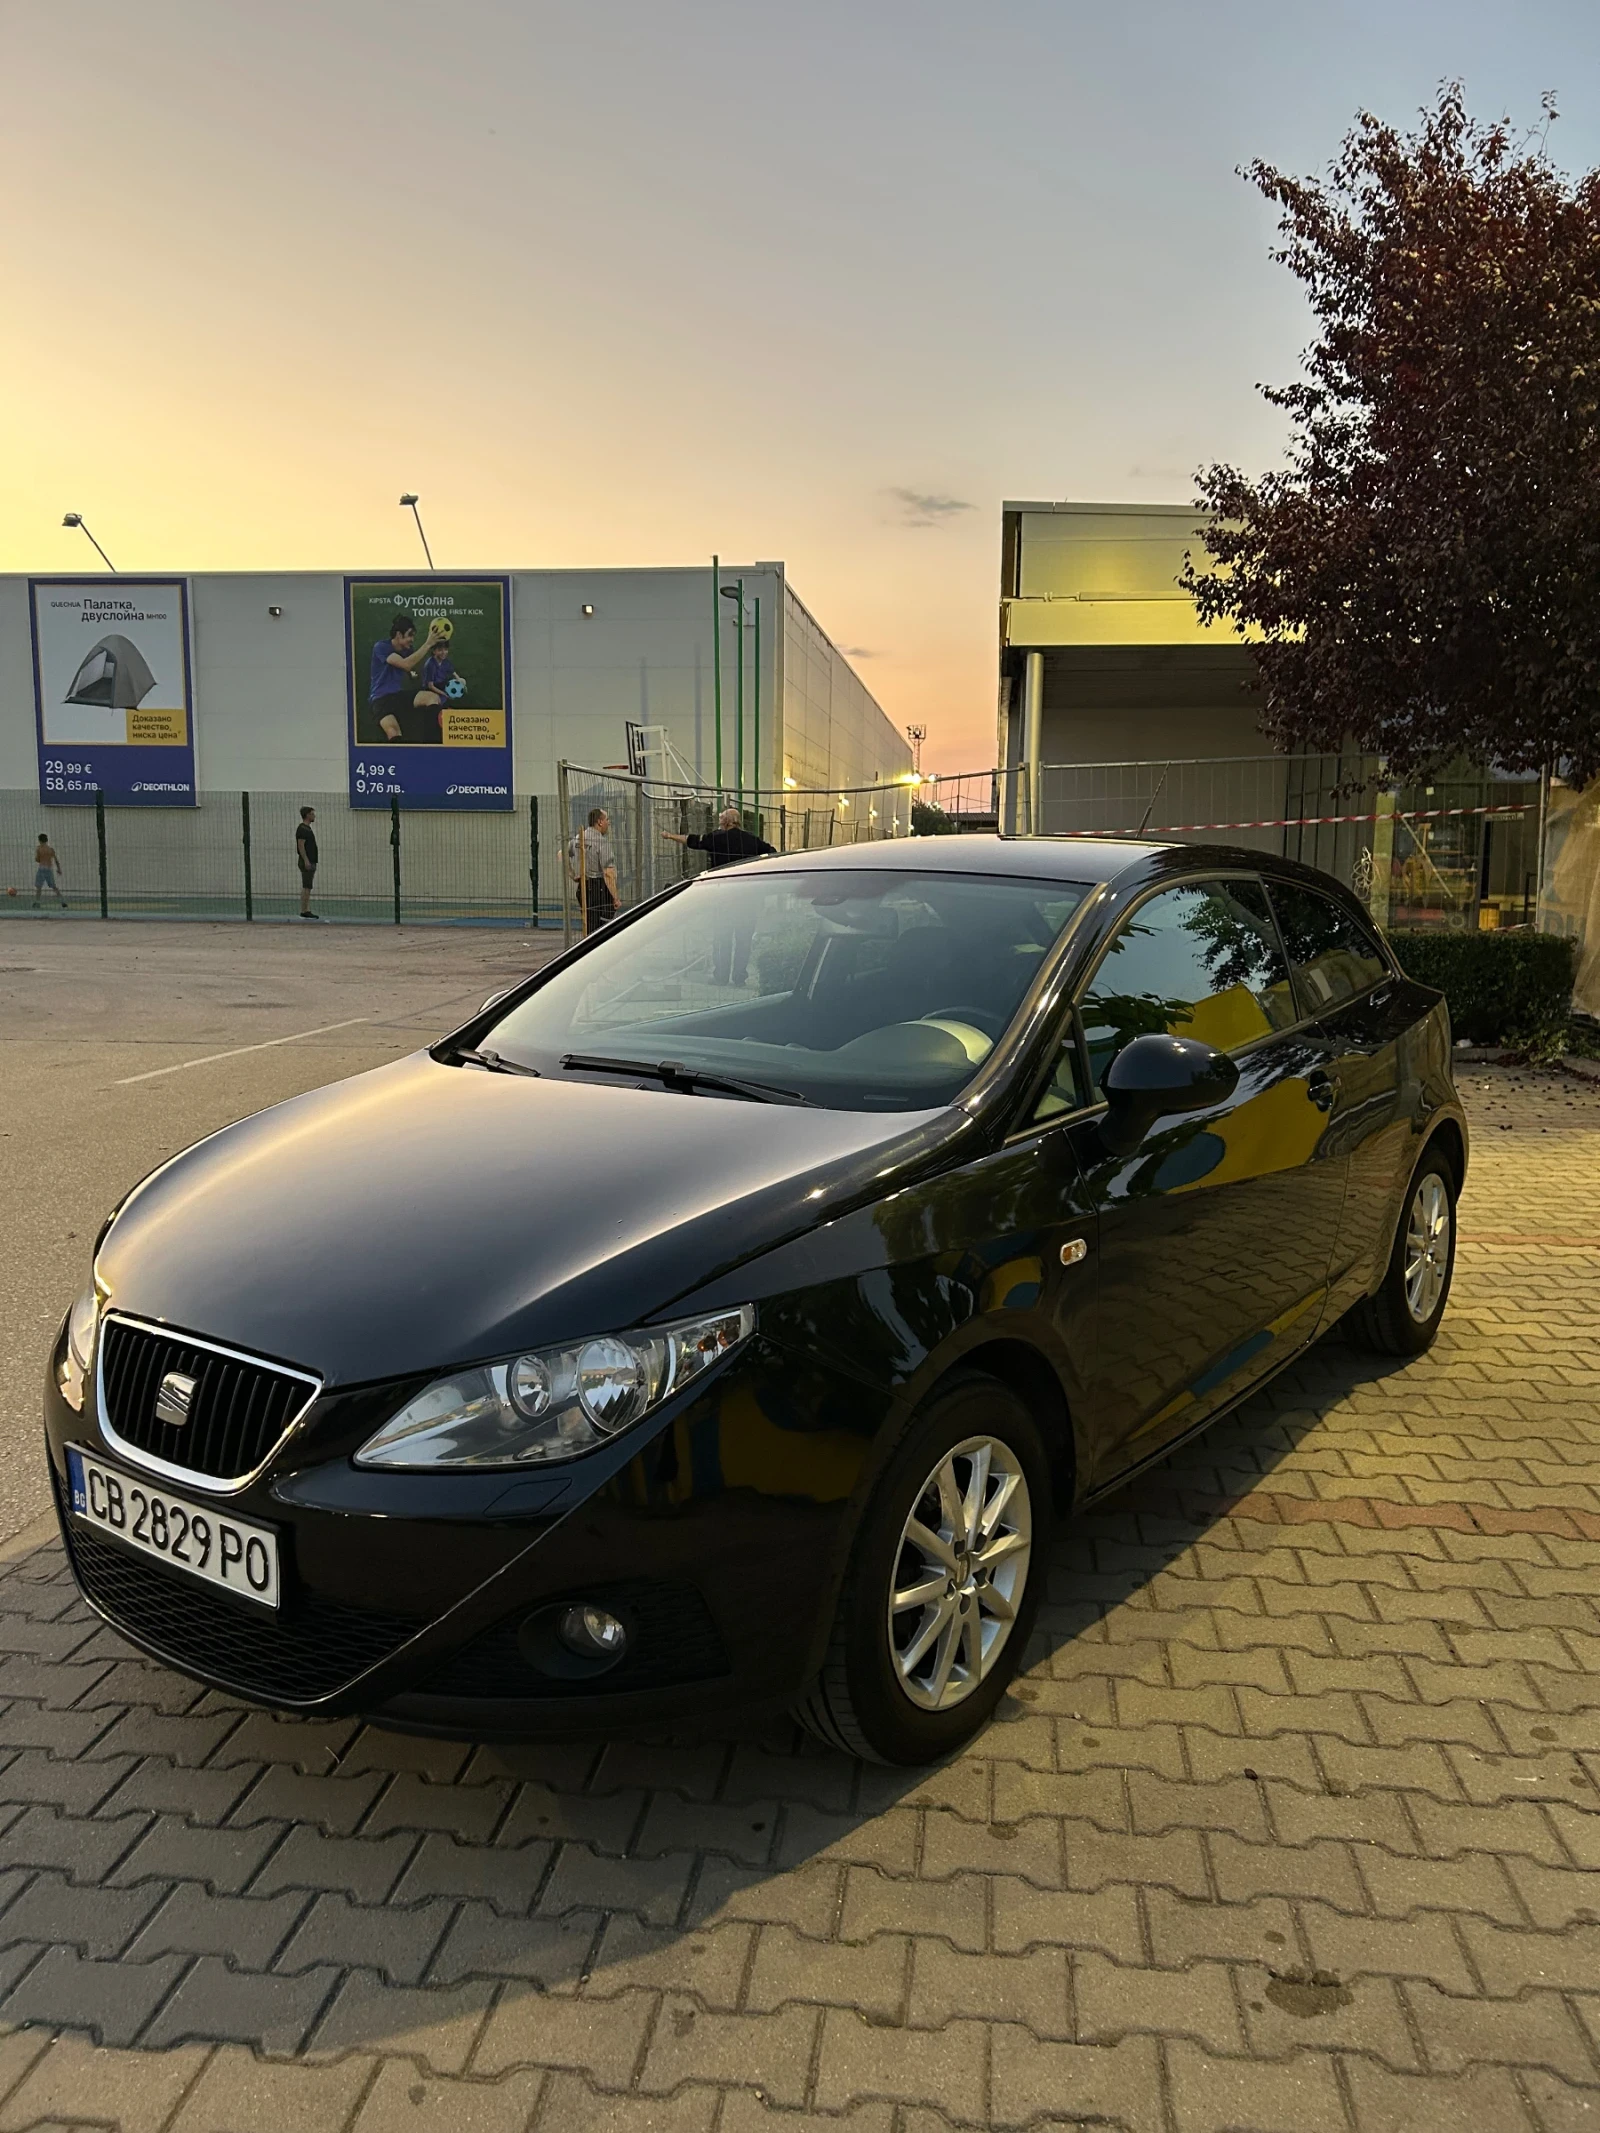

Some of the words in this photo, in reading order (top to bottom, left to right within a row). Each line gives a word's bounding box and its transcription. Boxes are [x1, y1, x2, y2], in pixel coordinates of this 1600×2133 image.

[83, 599, 136, 611] Палатка,
[393, 594, 454, 608] Футболна
[81, 611, 145, 623] двуслойна
[412, 608, 447, 617] топка
[132, 714, 172, 723] Доказано
[448, 715, 490, 724] Доказано
[132, 724, 172, 732] качество,
[448, 725, 490, 733] качество,
[45, 760, 82, 775] 29,99
[84, 763, 92, 774] €
[356, 762, 385, 777] 4,99
[387, 765, 396, 776] €
[46, 777, 82, 792] 58,65
[83, 781, 102, 791] лв.
[143, 783, 190, 792] DECATHLON
[356, 779, 384, 795] 9,76
[386, 784, 405, 793] лв.
[458, 785, 508, 795] DECATHLON
[73, 1489, 86, 1508] BG
[88, 1466, 126, 1529] CB
[130, 1488, 212, 1569] 2829
